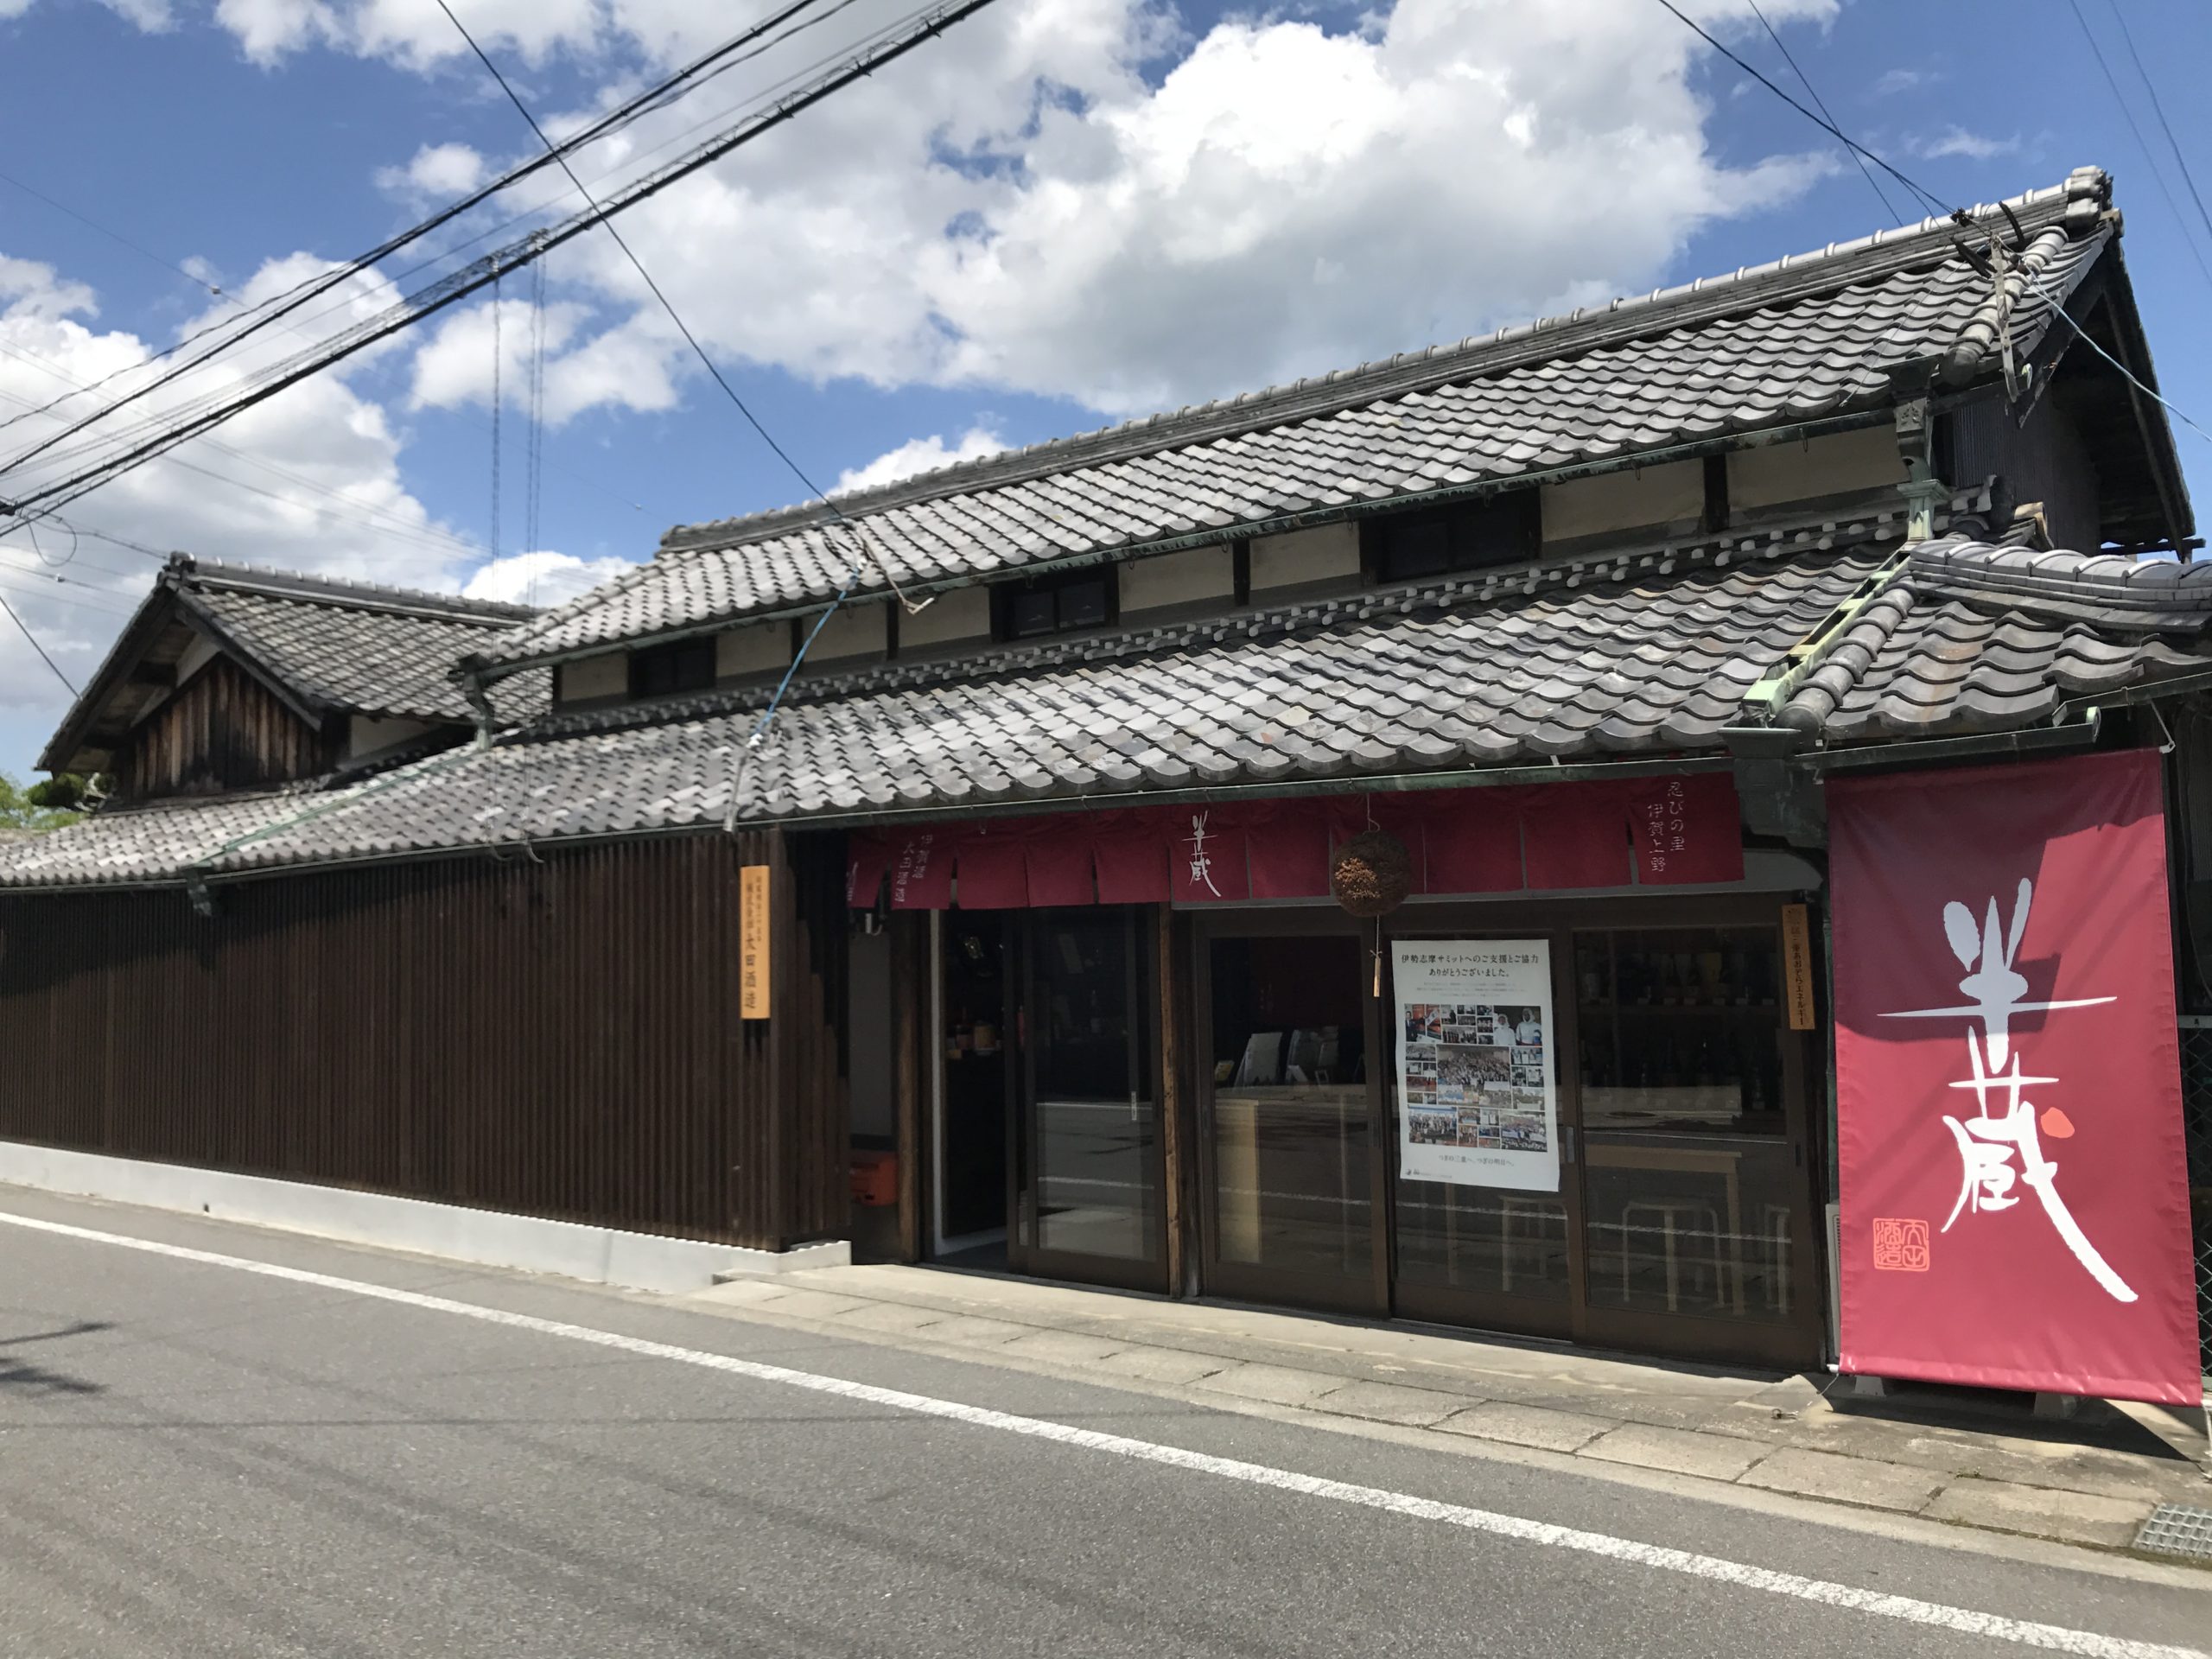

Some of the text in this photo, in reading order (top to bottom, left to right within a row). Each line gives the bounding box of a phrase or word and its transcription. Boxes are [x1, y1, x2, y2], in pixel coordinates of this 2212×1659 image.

[1647, 803, 1667, 872] 伊賀上野
[1667, 781, 1685, 852] 忍びの里
[1181, 810, 1222, 898] 半蔵
[1402, 953, 1539, 965] 伊勢志摩サミットへのご支援とご協力
[1428, 967, 1510, 978] ありがとうございました。
[1877, 877, 2138, 1303] 半蔵
